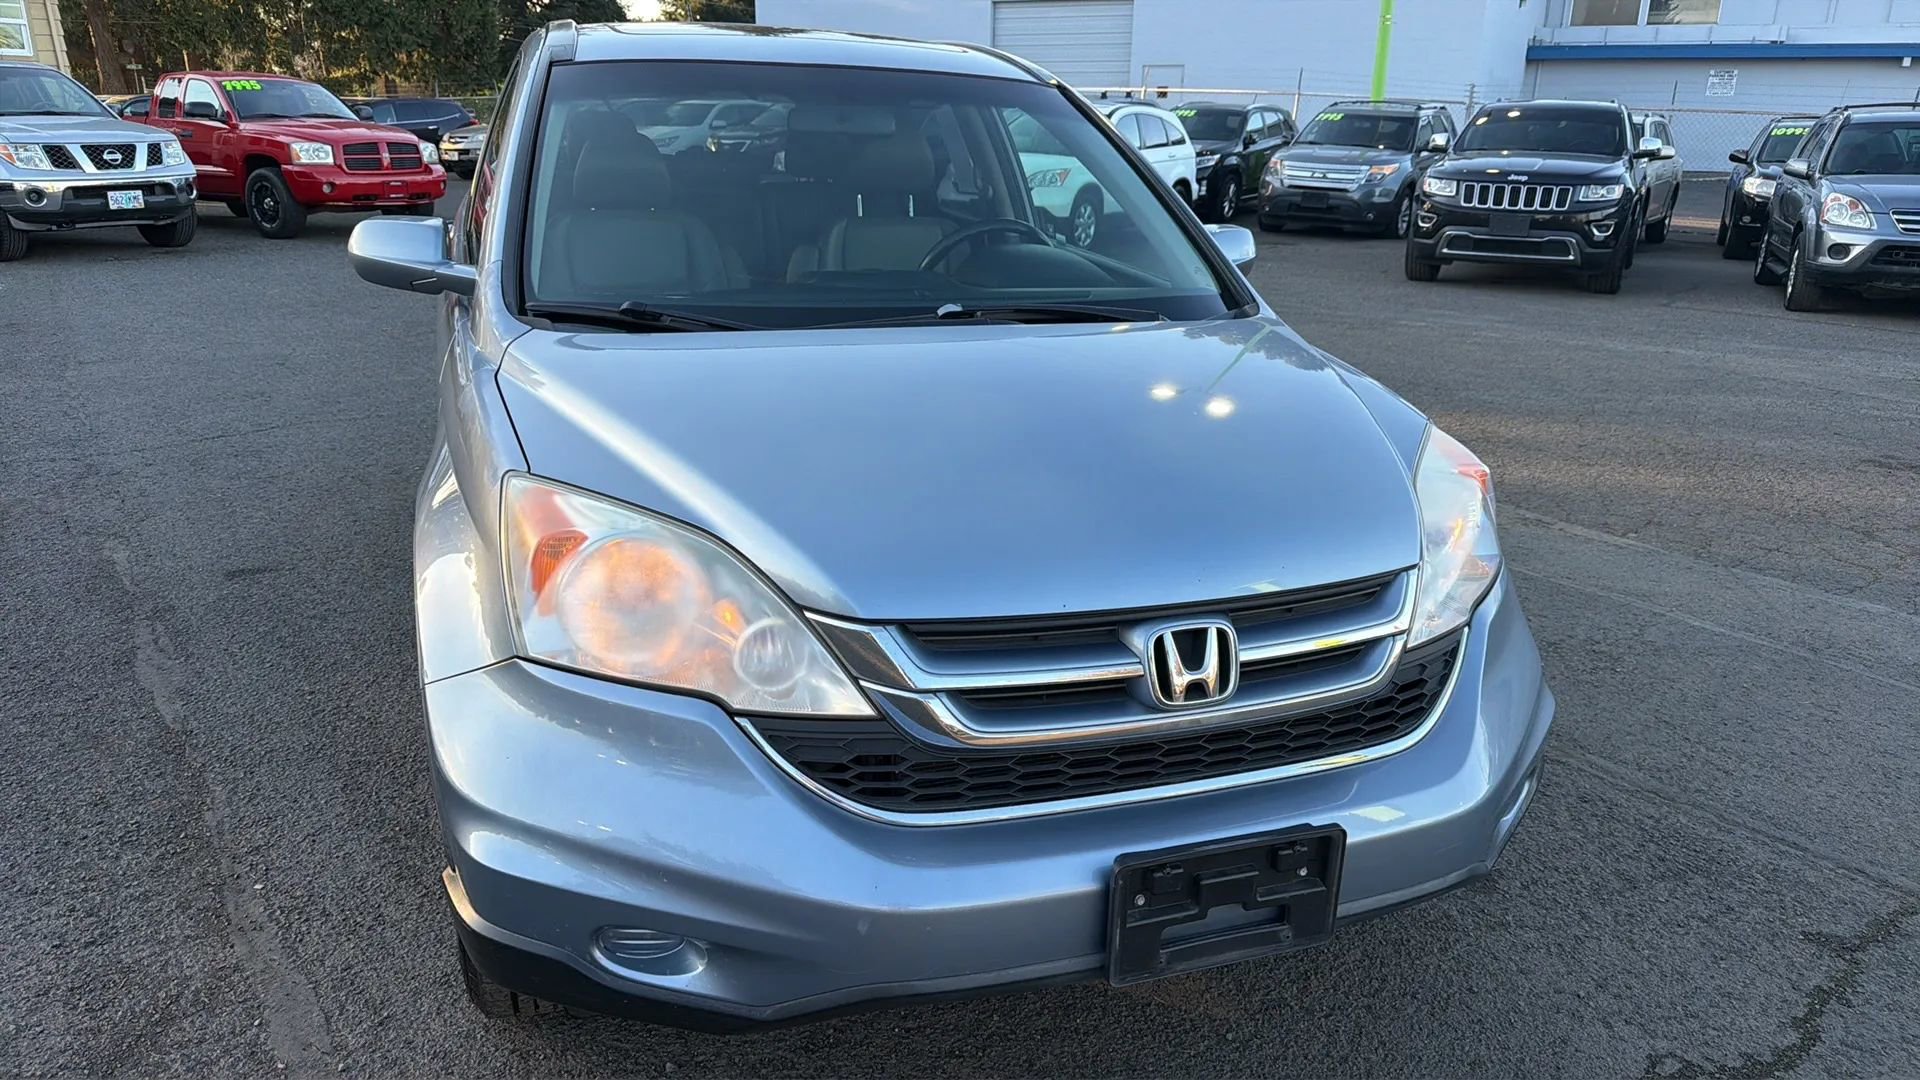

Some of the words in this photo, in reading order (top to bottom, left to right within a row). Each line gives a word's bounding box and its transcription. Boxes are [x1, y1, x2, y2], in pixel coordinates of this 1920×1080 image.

[222, 80, 262, 91] 7995
[1507, 173, 1528, 182] Jeep
[110, 195, 125, 206] 562
